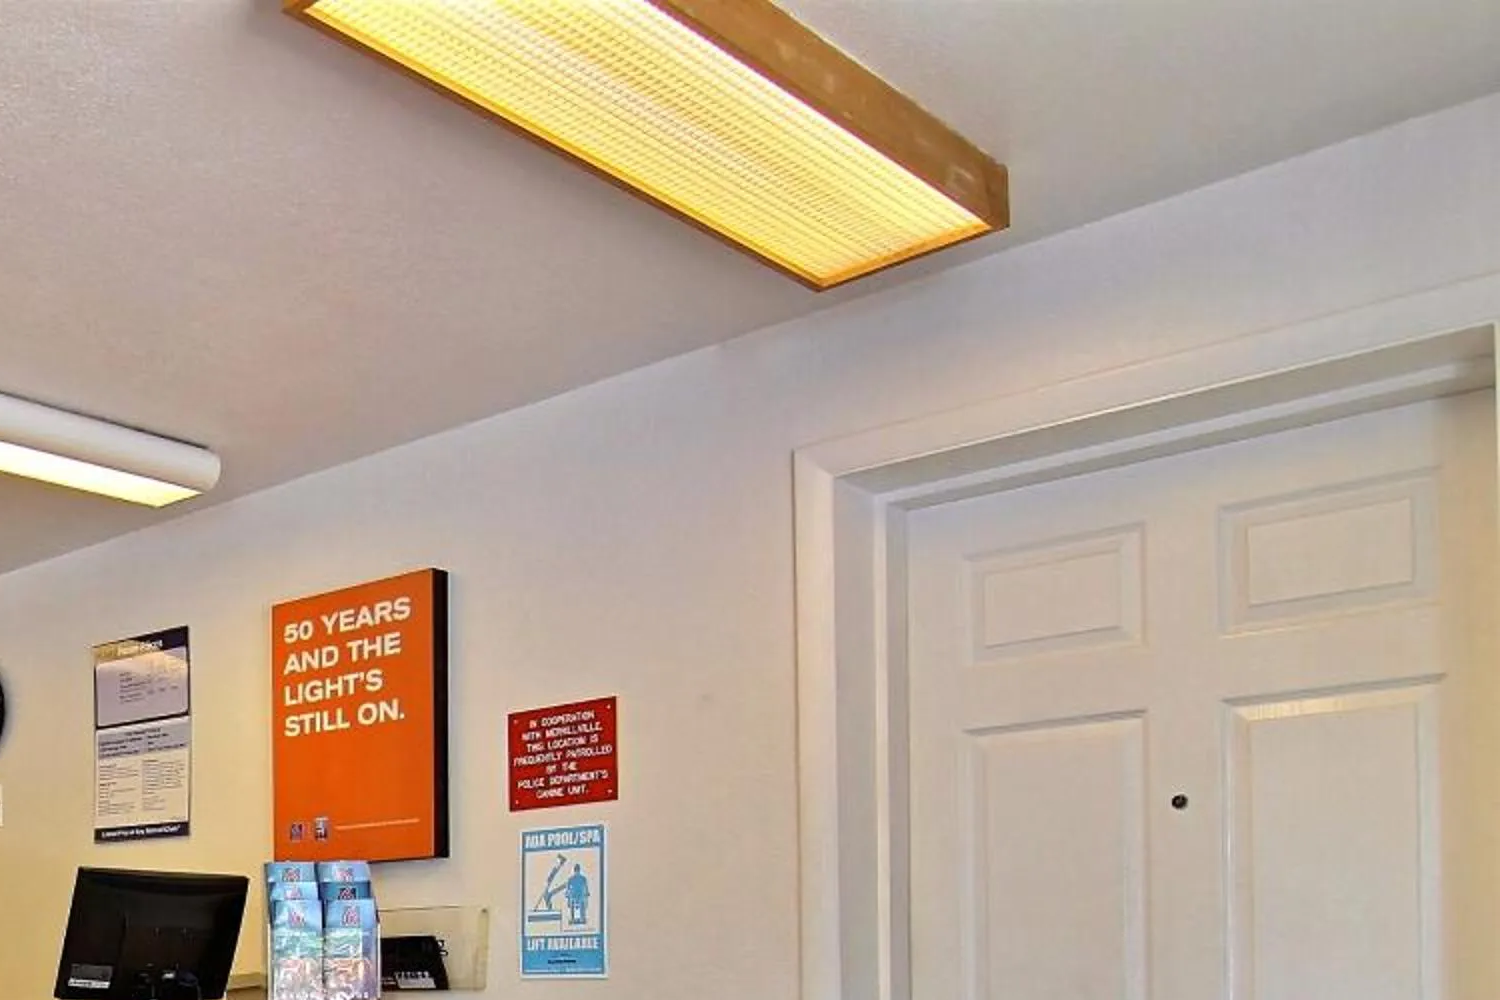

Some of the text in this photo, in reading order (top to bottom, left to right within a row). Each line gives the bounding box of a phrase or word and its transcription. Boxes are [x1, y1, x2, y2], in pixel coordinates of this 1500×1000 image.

[283, 596, 412, 644] 50 YEARS
[283, 631, 402, 676] AND THE
[284, 668, 384, 707] LIGHT'S
[284, 698, 405, 737] STILL ON.
[548, 736, 586, 750] LOCATION
[566, 744, 612, 757] PATROLLED
[517, 778, 545, 788] POLICE
[527, 938, 545, 951] LIFT
